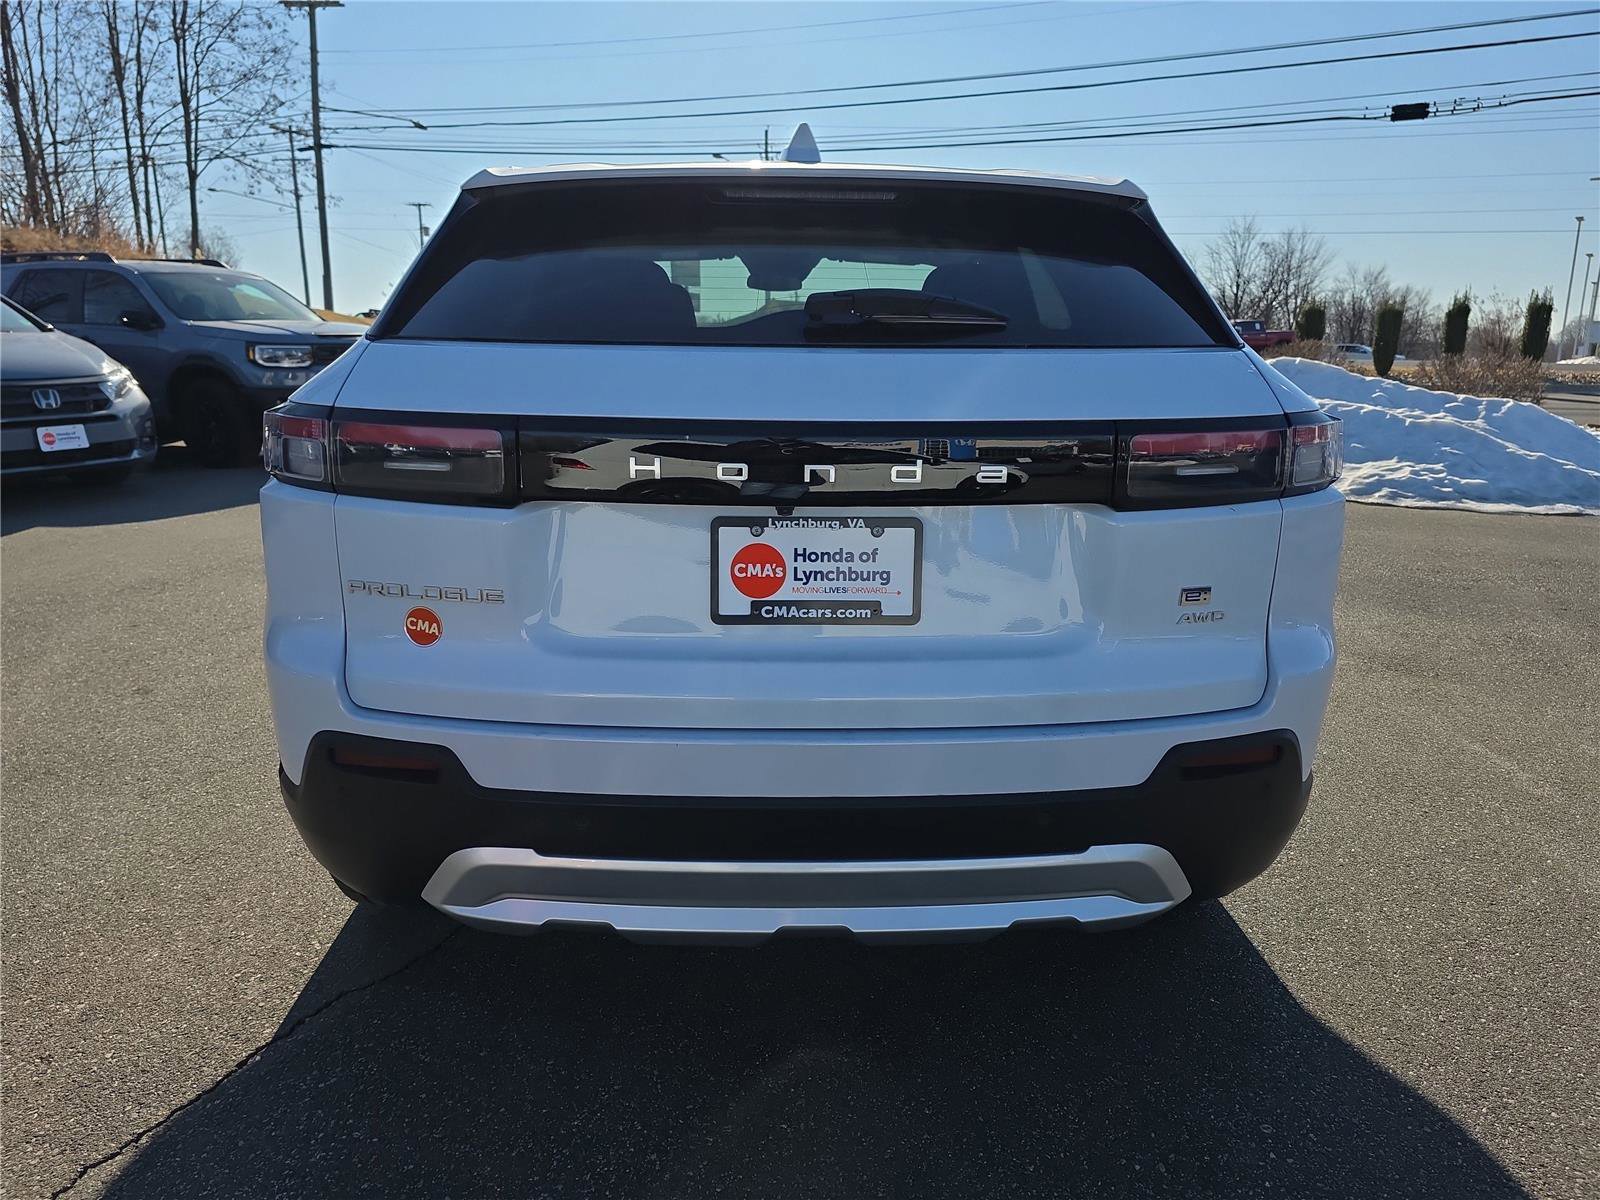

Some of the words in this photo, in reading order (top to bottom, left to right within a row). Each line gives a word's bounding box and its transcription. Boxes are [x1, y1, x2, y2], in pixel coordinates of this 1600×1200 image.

[629, 457, 1008, 484] Honda
[768, 518, 844, 530] Lynchburg,
[848, 518, 866, 529] VA
[793, 548, 855, 563] Honda
[859, 548, 878, 563] of
[734, 563, 784, 578] CMA's
[793, 567, 891, 585] Lynchburg
[347, 580, 505, 604] PROLOGUE
[761, 606, 871, 618] CMAcars.com
[1176, 610, 1225, 625] AWD
[406, 617, 439, 636] CMA
